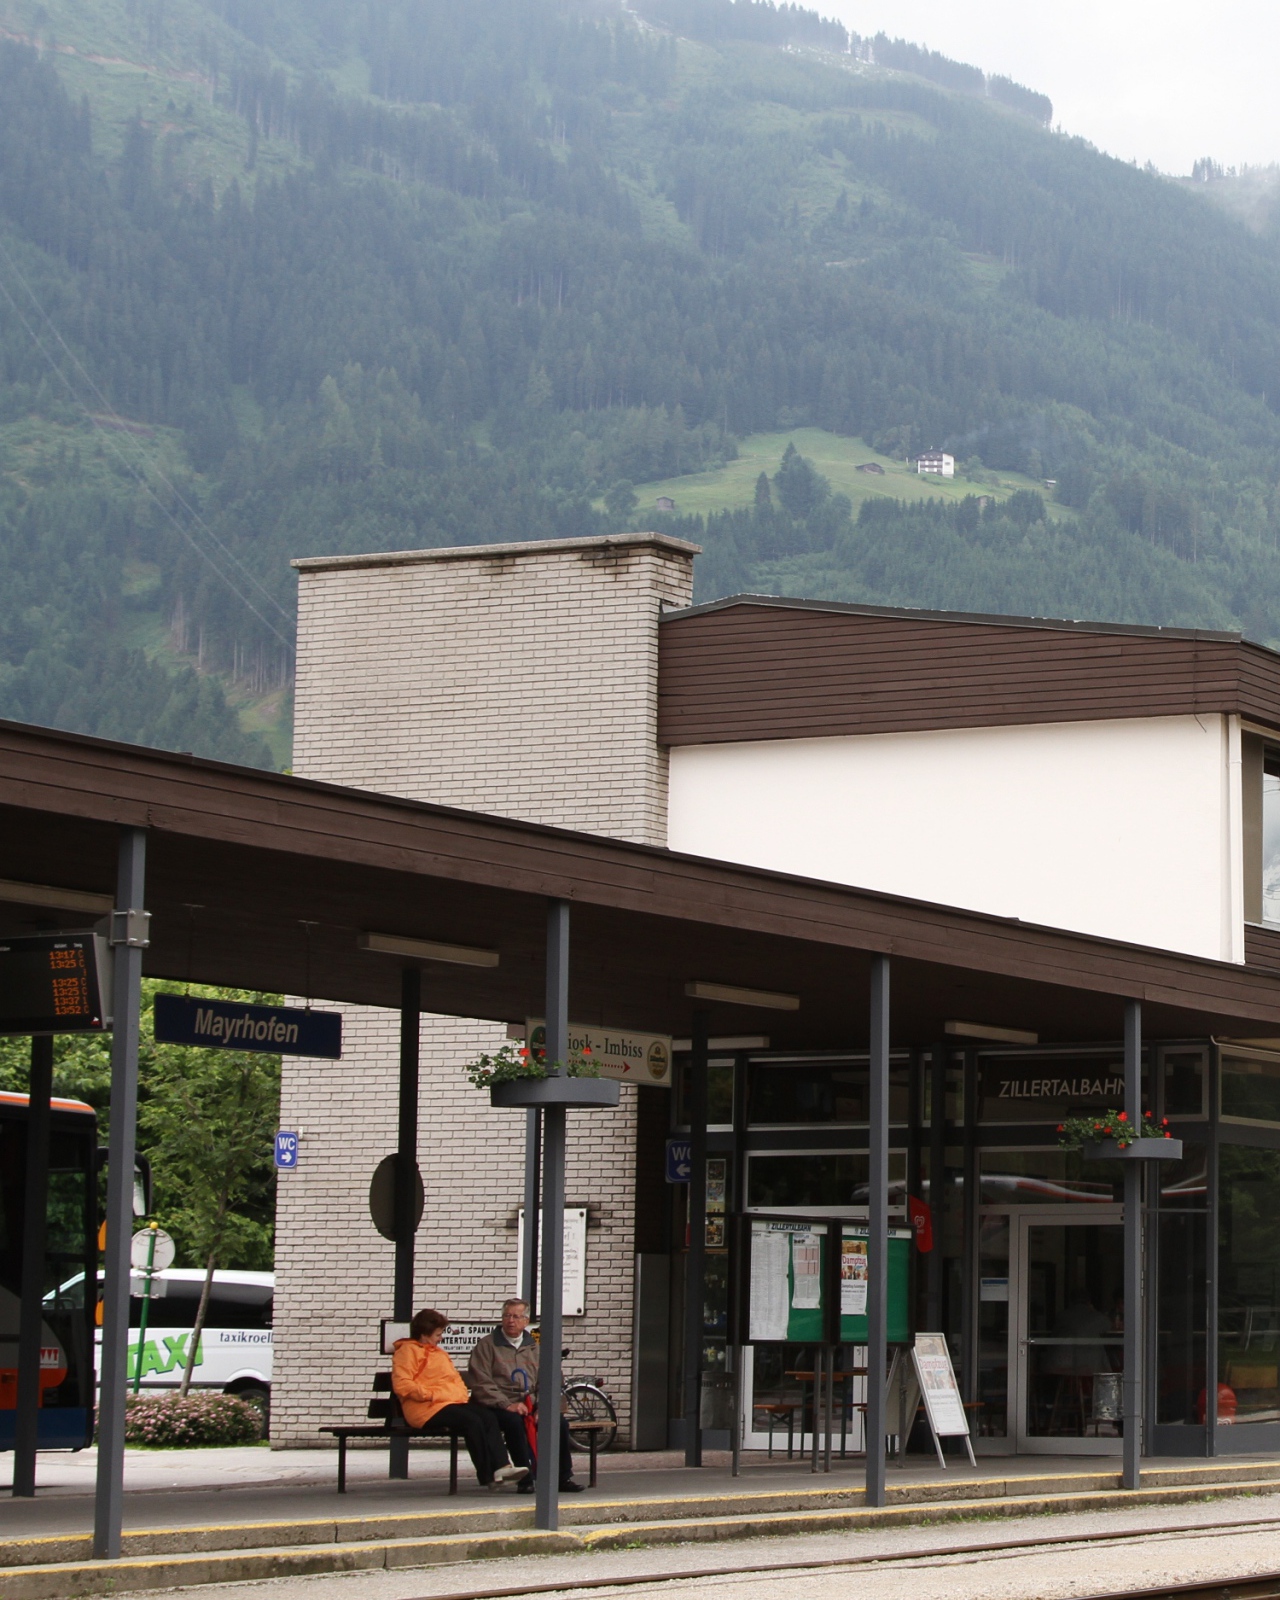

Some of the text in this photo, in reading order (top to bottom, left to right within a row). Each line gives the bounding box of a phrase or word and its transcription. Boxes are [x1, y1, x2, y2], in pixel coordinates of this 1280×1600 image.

[49, 950, 76, 960] 13:17
[50, 960, 77, 969] 13:25
[52, 978, 79, 987] 13:25
[53, 987, 80, 996] 13:25
[54, 996, 80, 1006] 13:37
[55, 1006, 81, 1015] 13:52
[194, 1008, 299, 1044] Mayrhofen
[567, 1033, 593, 1054] iosk
[604, 1037, 643, 1059] Imbiss
[278, 1137, 296, 1151] WC
[771, 1222, 812, 1232] ZILLERTALBAHN
